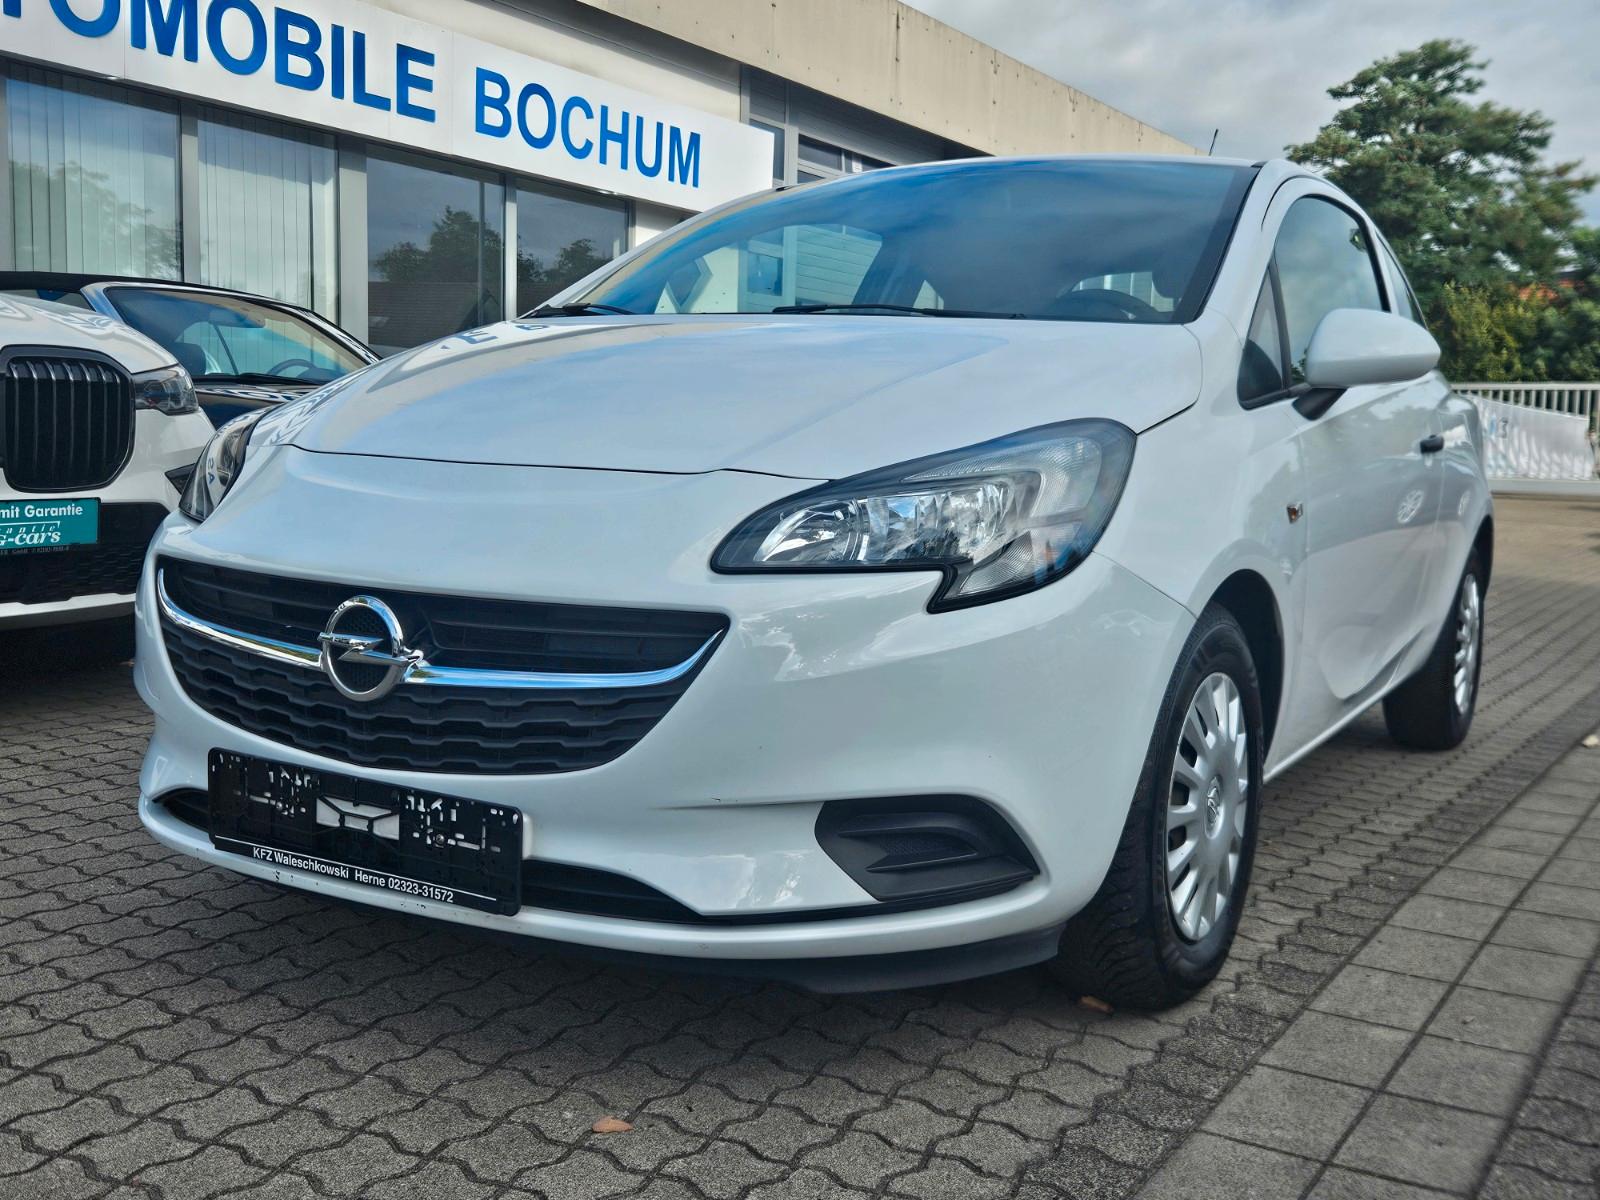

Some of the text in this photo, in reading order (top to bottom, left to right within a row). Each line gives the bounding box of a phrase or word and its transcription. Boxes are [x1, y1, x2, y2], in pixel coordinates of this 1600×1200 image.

[2, 0, 700, 188] MOBILE BOCHUM
[0, 503, 83, 518] mit Garantie
[253, 846, 454, 903] KFZ Waleschkowski Herne 02323-31572
